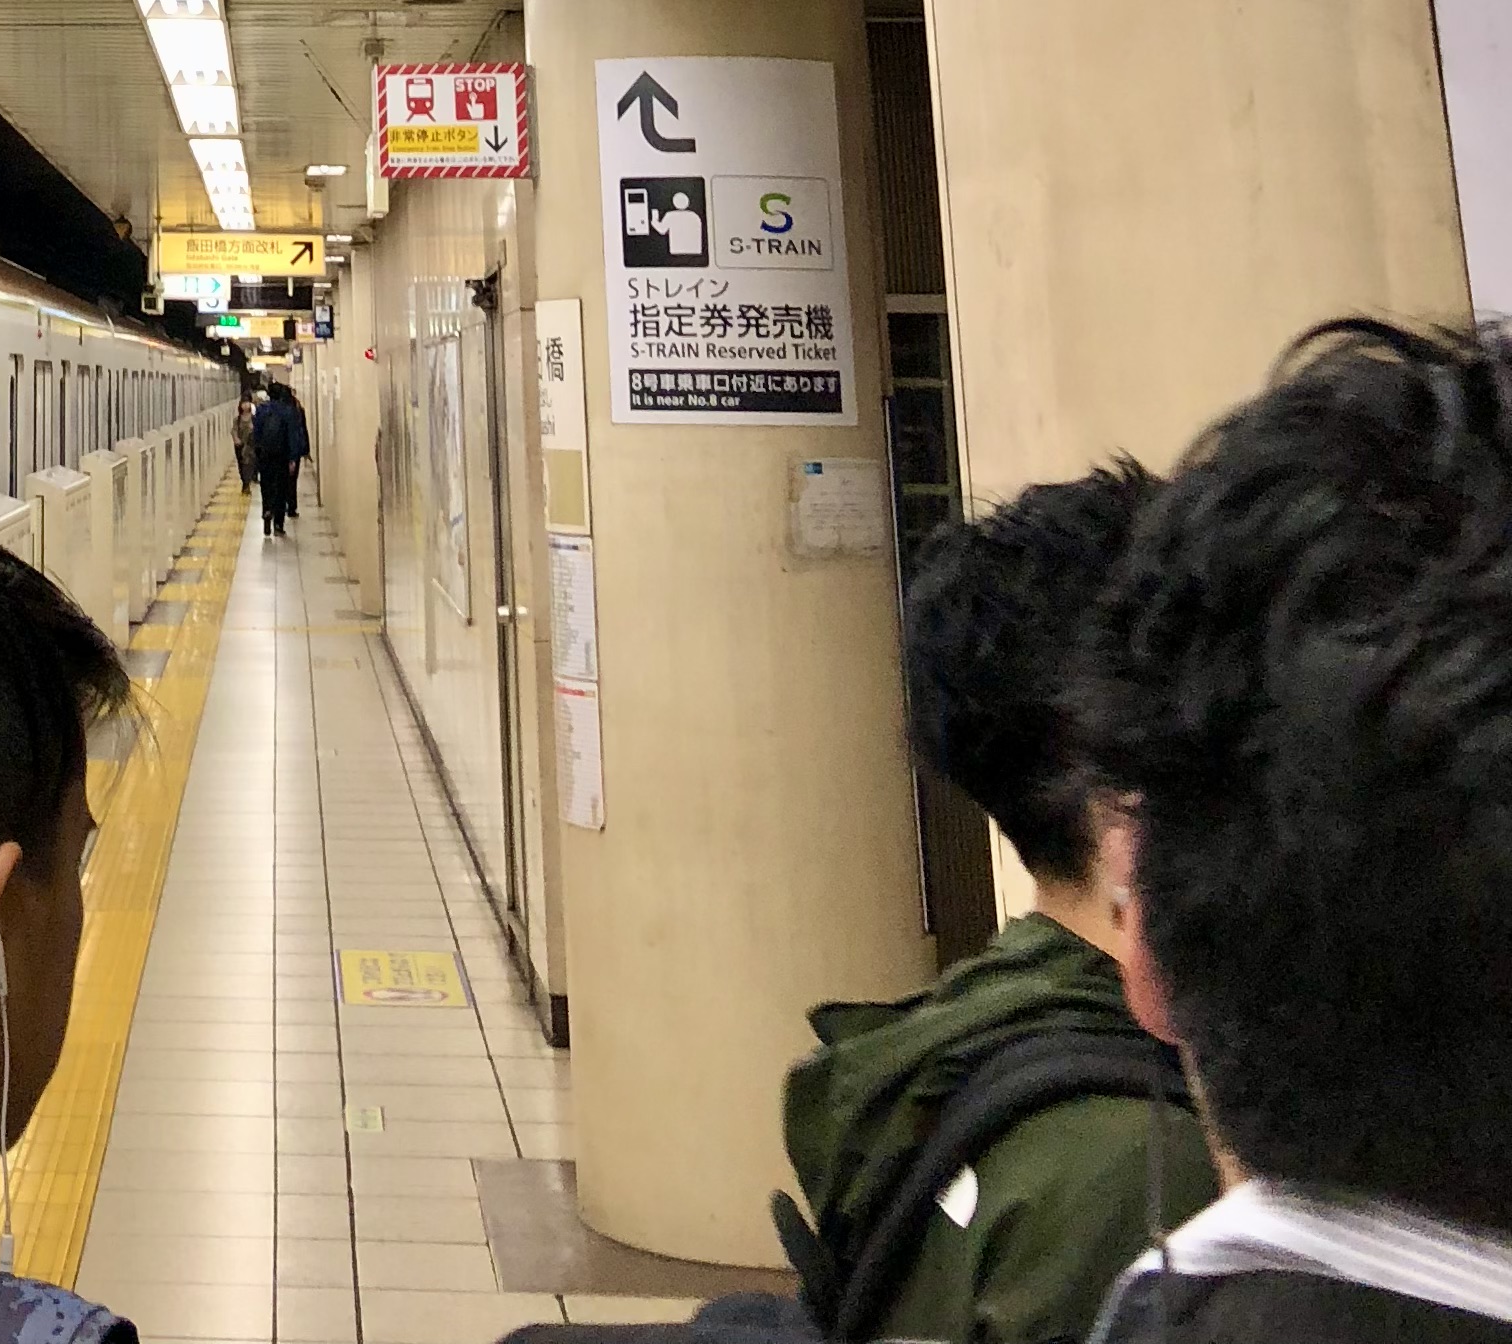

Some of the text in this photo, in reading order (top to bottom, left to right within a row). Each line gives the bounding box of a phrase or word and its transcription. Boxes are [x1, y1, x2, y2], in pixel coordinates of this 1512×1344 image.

[455, 78, 495, 93] STOP
[390, 127, 478, 143] 非常停止ボタン
[730, 237, 821, 255] S-TRAIN
[628, 277, 729, 299] Sトレイン
[630, 303, 834, 341] 指定券発売機
[630, 342, 837, 361] S-TRAIN Reserved Ticket
[632, 395, 641, 406] It
[644, 395, 653, 406] is
[657, 396, 684, 406] near
[721, 396, 740, 407] car
